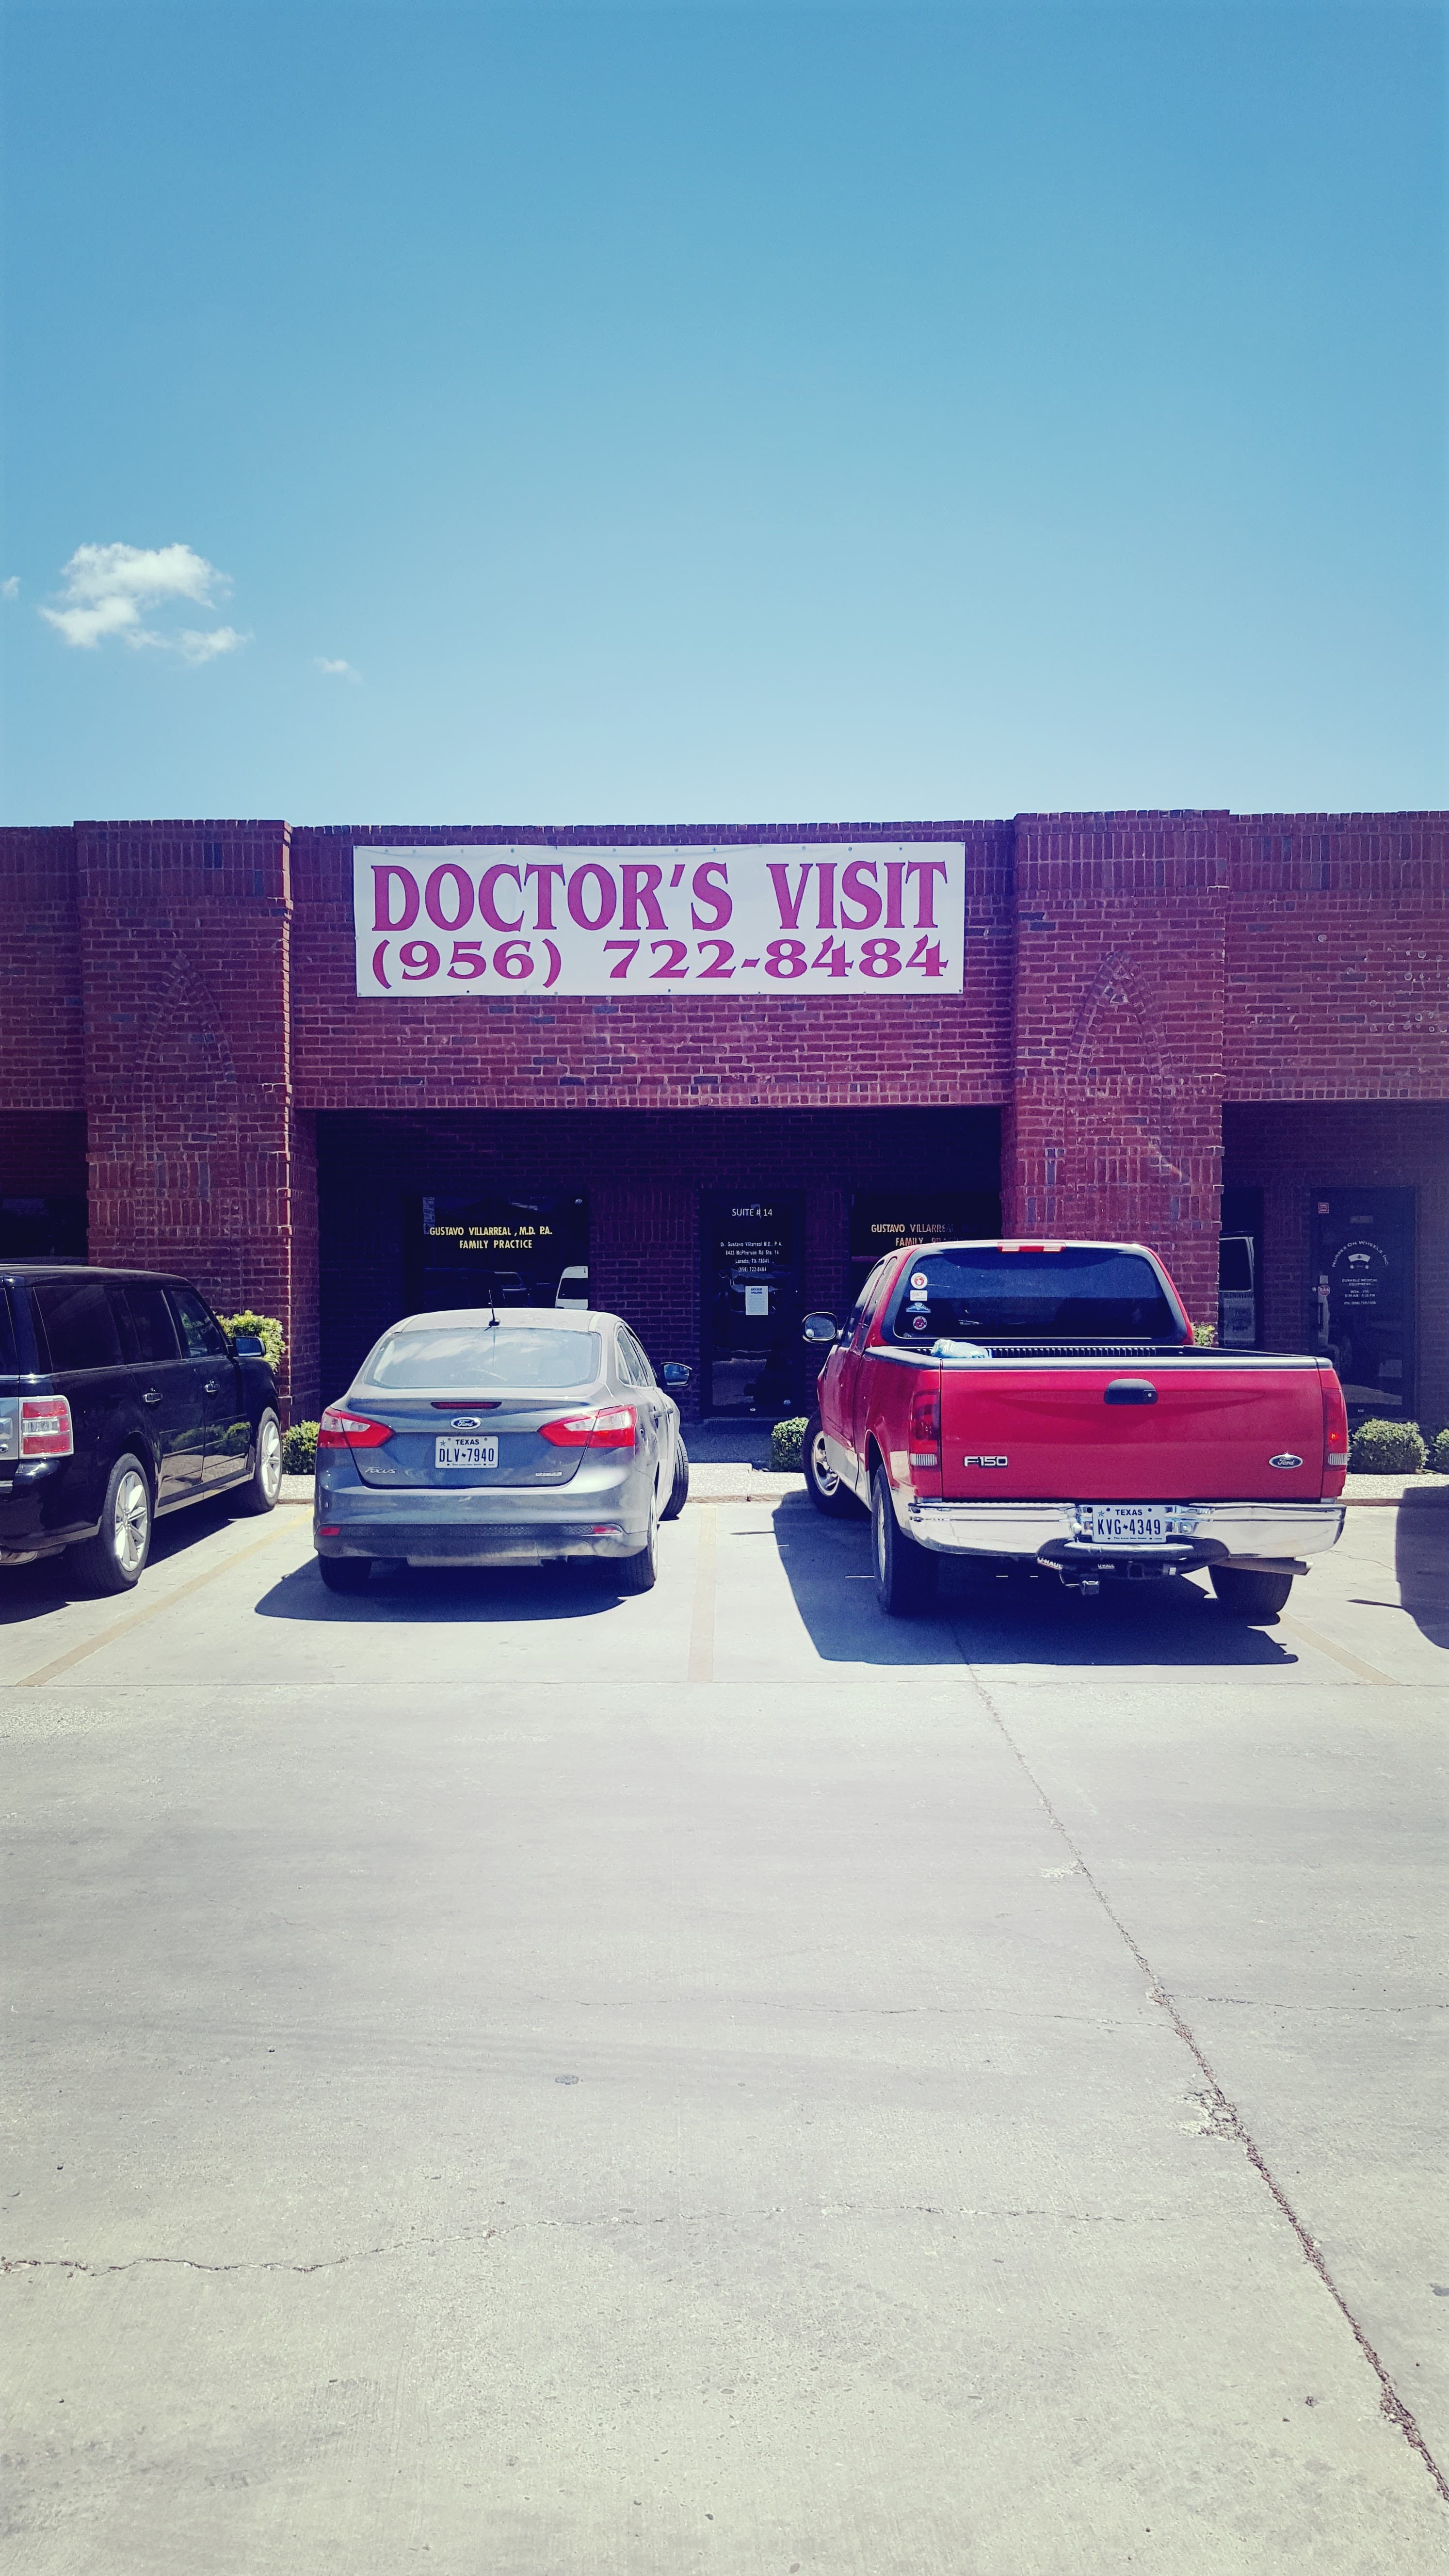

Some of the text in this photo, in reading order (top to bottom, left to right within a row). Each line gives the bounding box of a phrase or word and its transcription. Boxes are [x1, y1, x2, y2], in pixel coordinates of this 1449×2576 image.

[371, 860, 949, 932] DOCTOR'S VISIT
[372, 934, 949, 989] (956) 722-8484
[732, 1208, 754, 1216] SUITE
[430, 1227, 464, 1236] GUSTAVO
[468, 1226, 511, 1236] VILLARREAL
[871, 1224, 905, 1233] GUSTAVO
[459, 1240, 532, 1249] FAMILY PRACTICE
[895, 1237, 924, 1246] FAMILY
[1358, 1240, 1383, 1254] WHEELS
[1277, 1457, 1295, 1465] Ford
